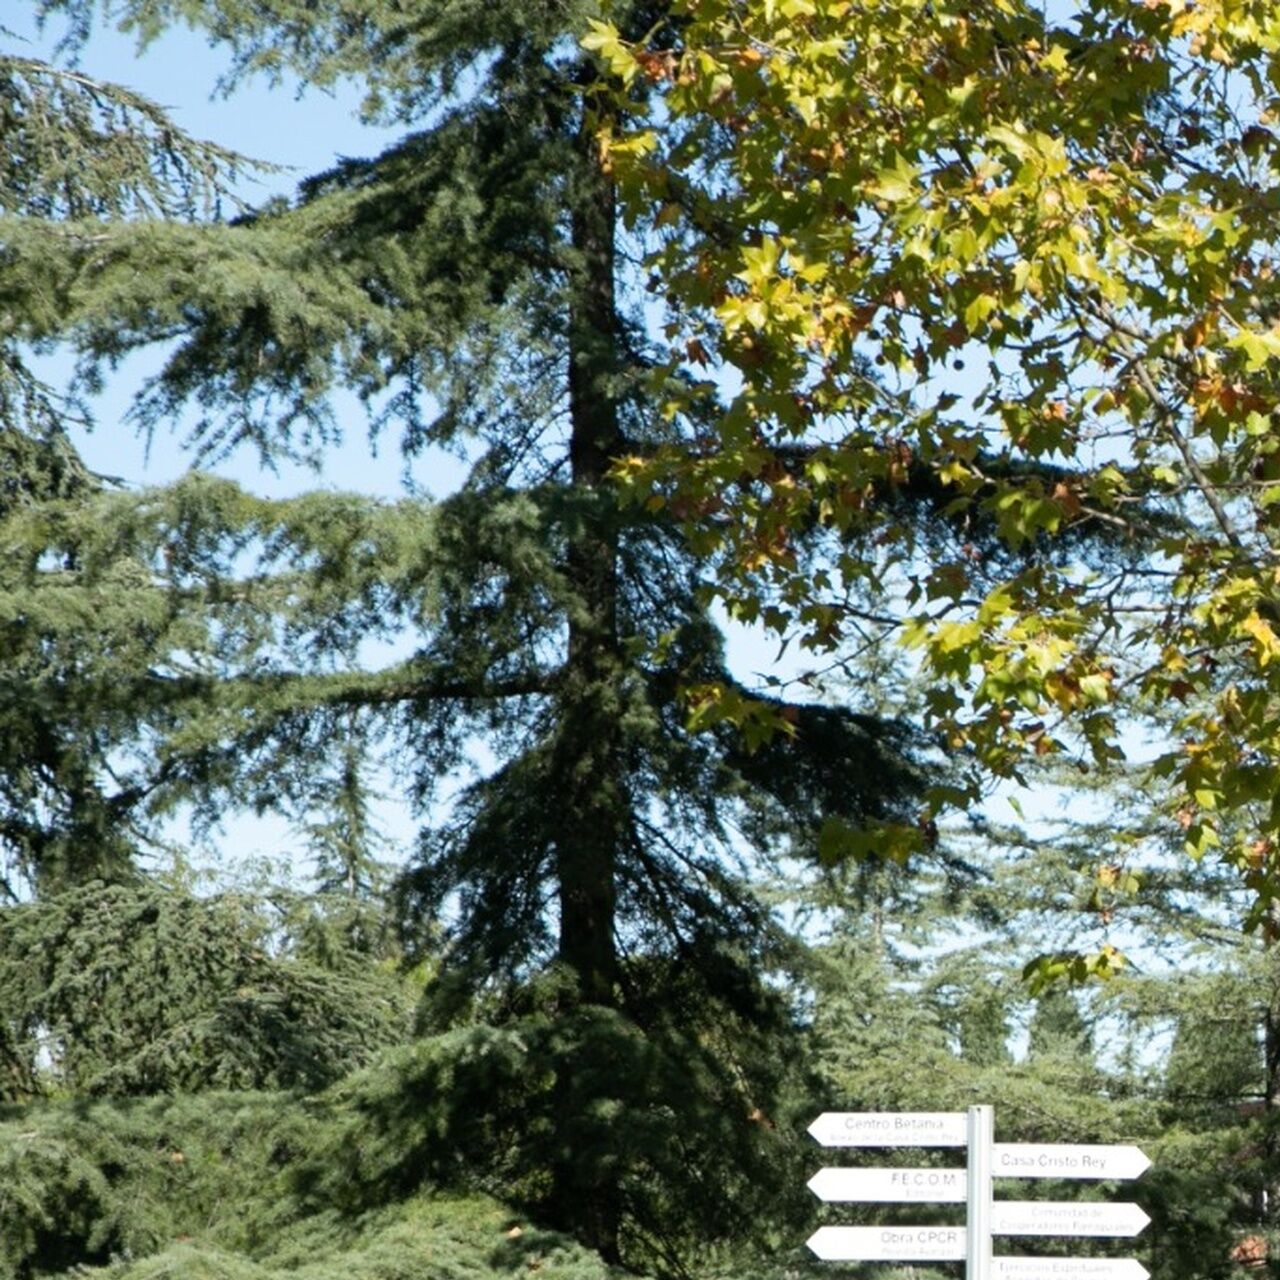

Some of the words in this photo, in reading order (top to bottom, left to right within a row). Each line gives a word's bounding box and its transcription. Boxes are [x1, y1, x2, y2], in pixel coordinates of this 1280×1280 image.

[844, 1117, 890, 1130] Centro
[894, 1117, 944, 1130] Betania
[1000, 1153, 1035, 1167] Casa
[1037, 1153, 1078, 1168] Cristo
[1081, 1154, 1106, 1169] Rey
[881, 1231, 913, 1244] Obra
[917, 1231, 957, 1244] CPCR
